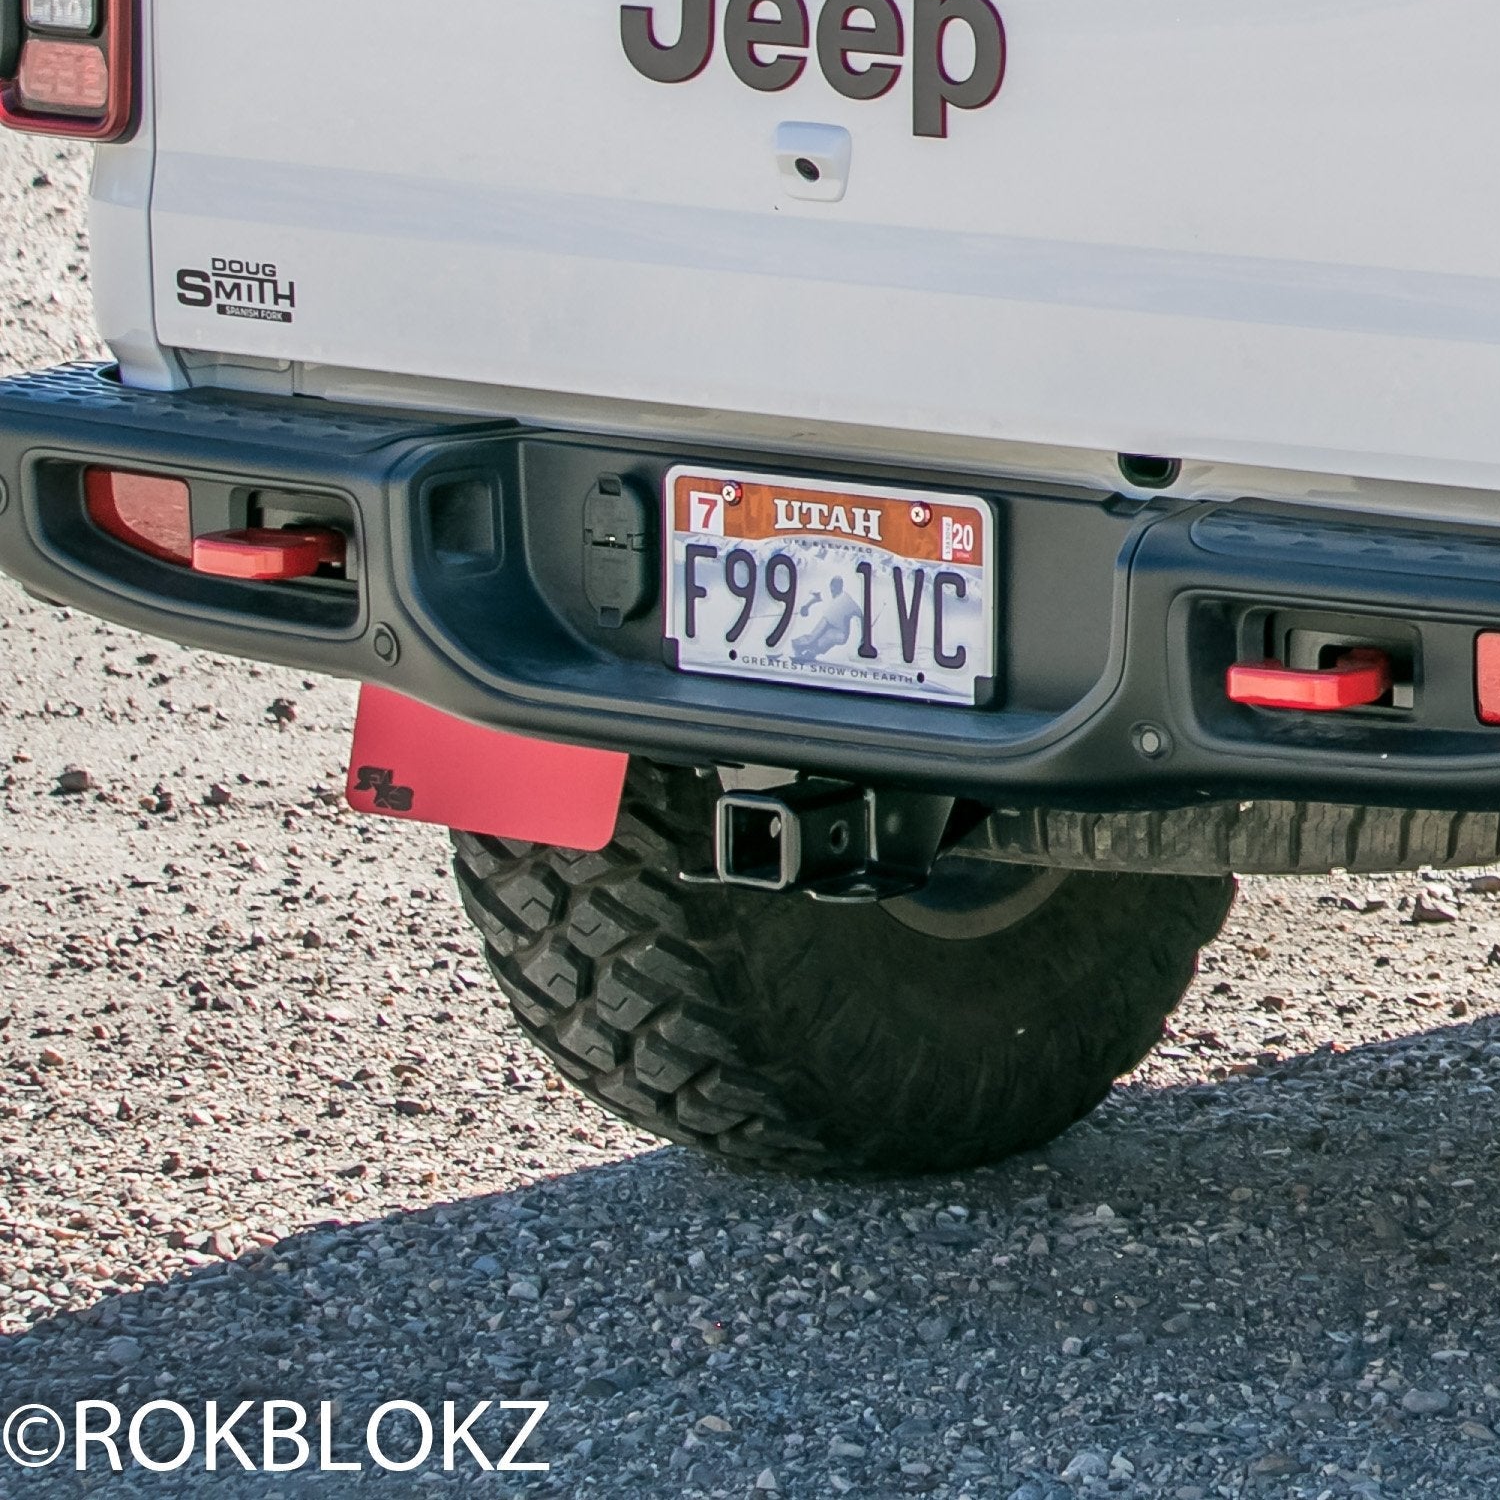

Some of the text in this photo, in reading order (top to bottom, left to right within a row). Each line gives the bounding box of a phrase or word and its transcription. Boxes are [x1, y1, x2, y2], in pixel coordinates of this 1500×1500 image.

[212, 258, 276, 277] DOUG
[177, 269, 296, 308] SMITH
[225, 305, 283, 322] SPANISH FORK
[697, 498, 718, 529] 7
[774, 498, 882, 541] UTAH
[952, 522, 974, 552] 20
[684, 544, 967, 669] F99 1VC
[742, 656, 913, 684] GREATEST SNOW ON EARTH
